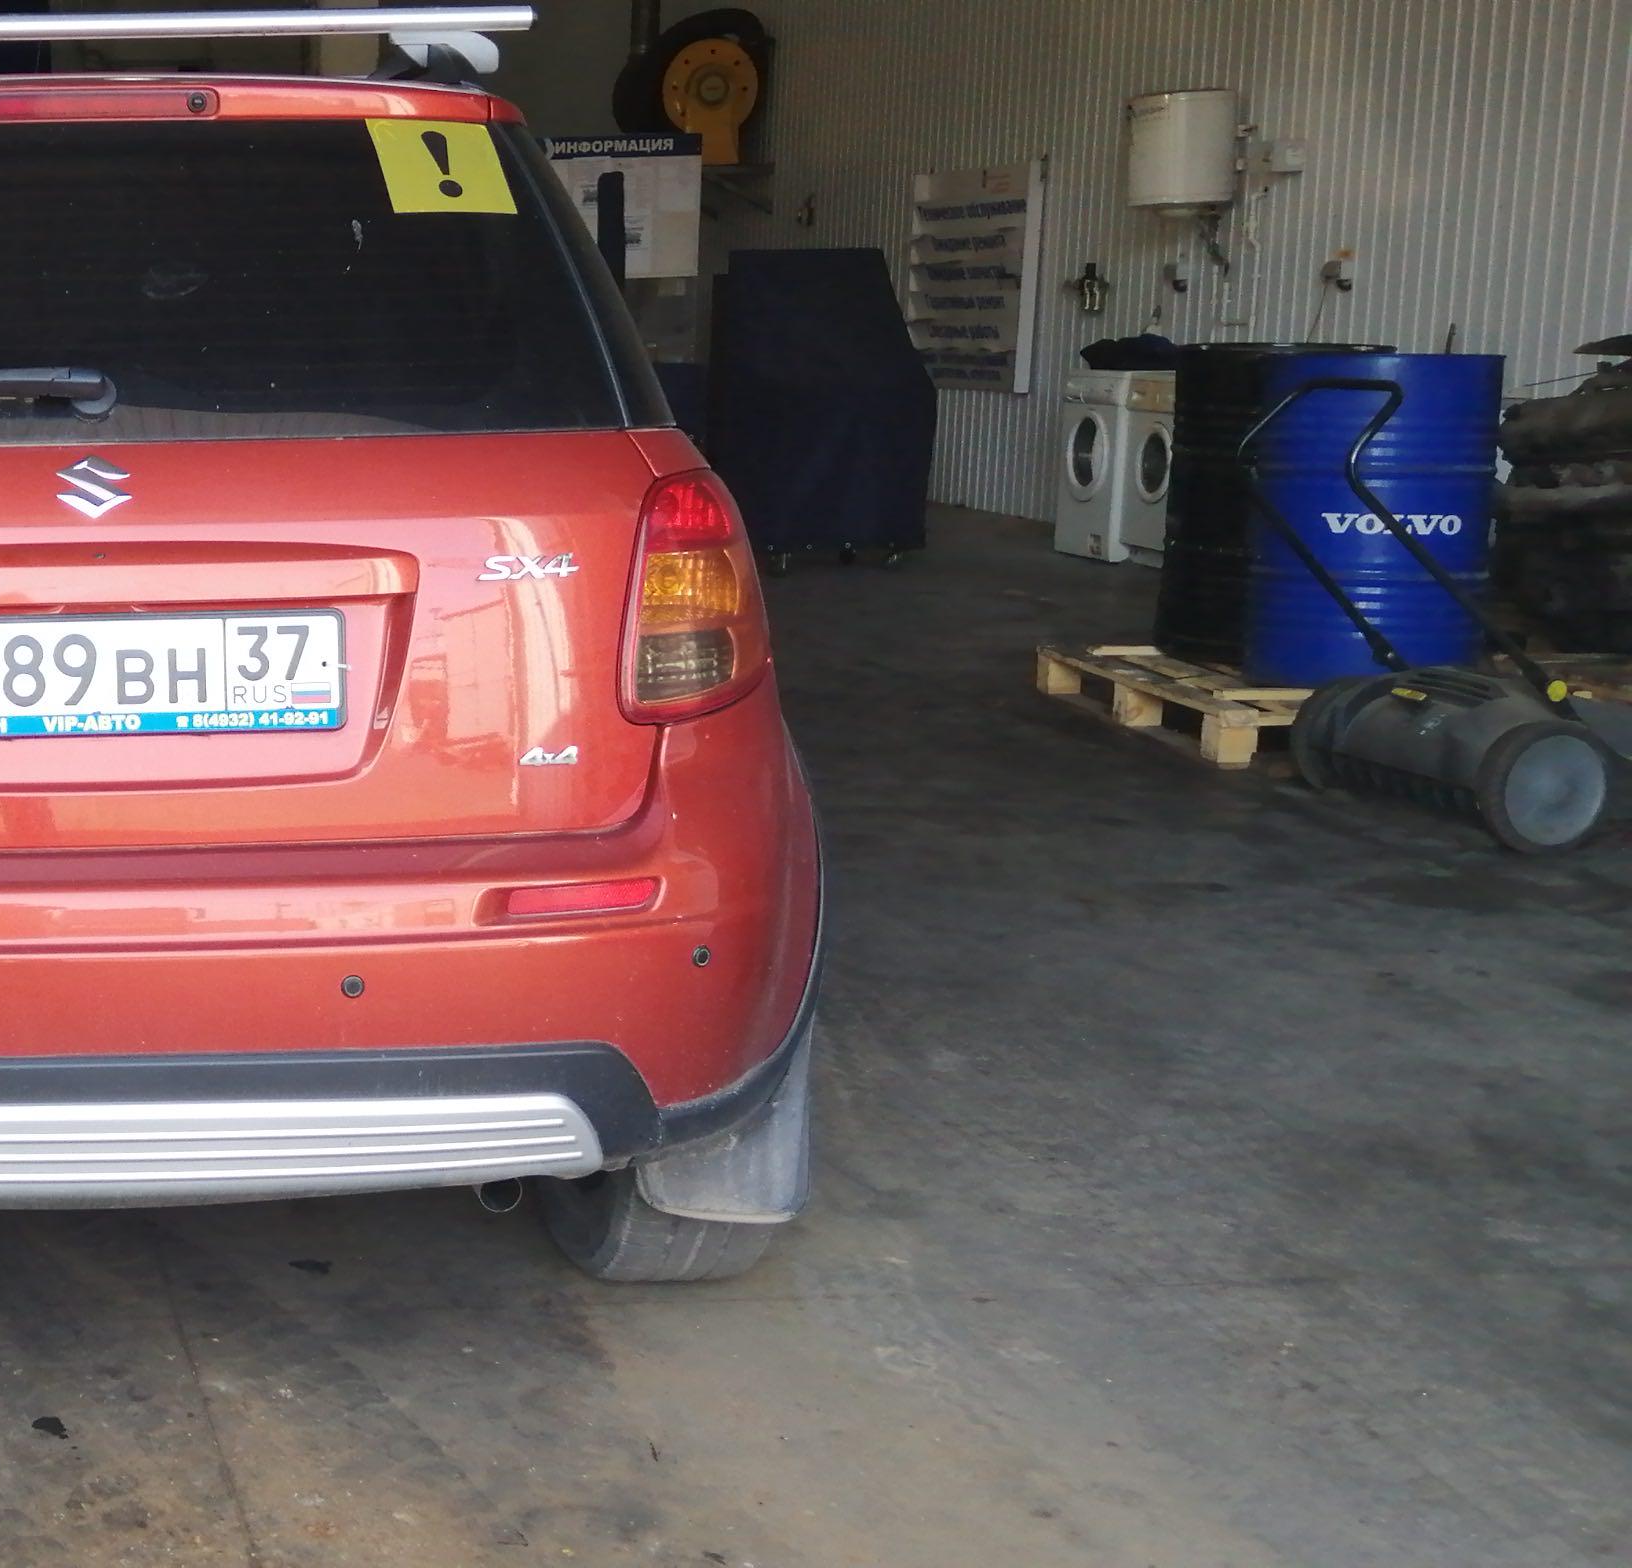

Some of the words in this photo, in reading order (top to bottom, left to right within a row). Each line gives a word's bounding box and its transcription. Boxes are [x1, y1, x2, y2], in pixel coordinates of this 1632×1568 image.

[554, 138, 674, 155] ИНФОРМАЦИЯ
[477, 552, 580, 581] SX4
[237, 625, 309, 681] 37
[233, 685, 287, 703] RUS
[192, 711, 255, 728] 8(4932)
[258, 710, 329, 726] 41-92-91
